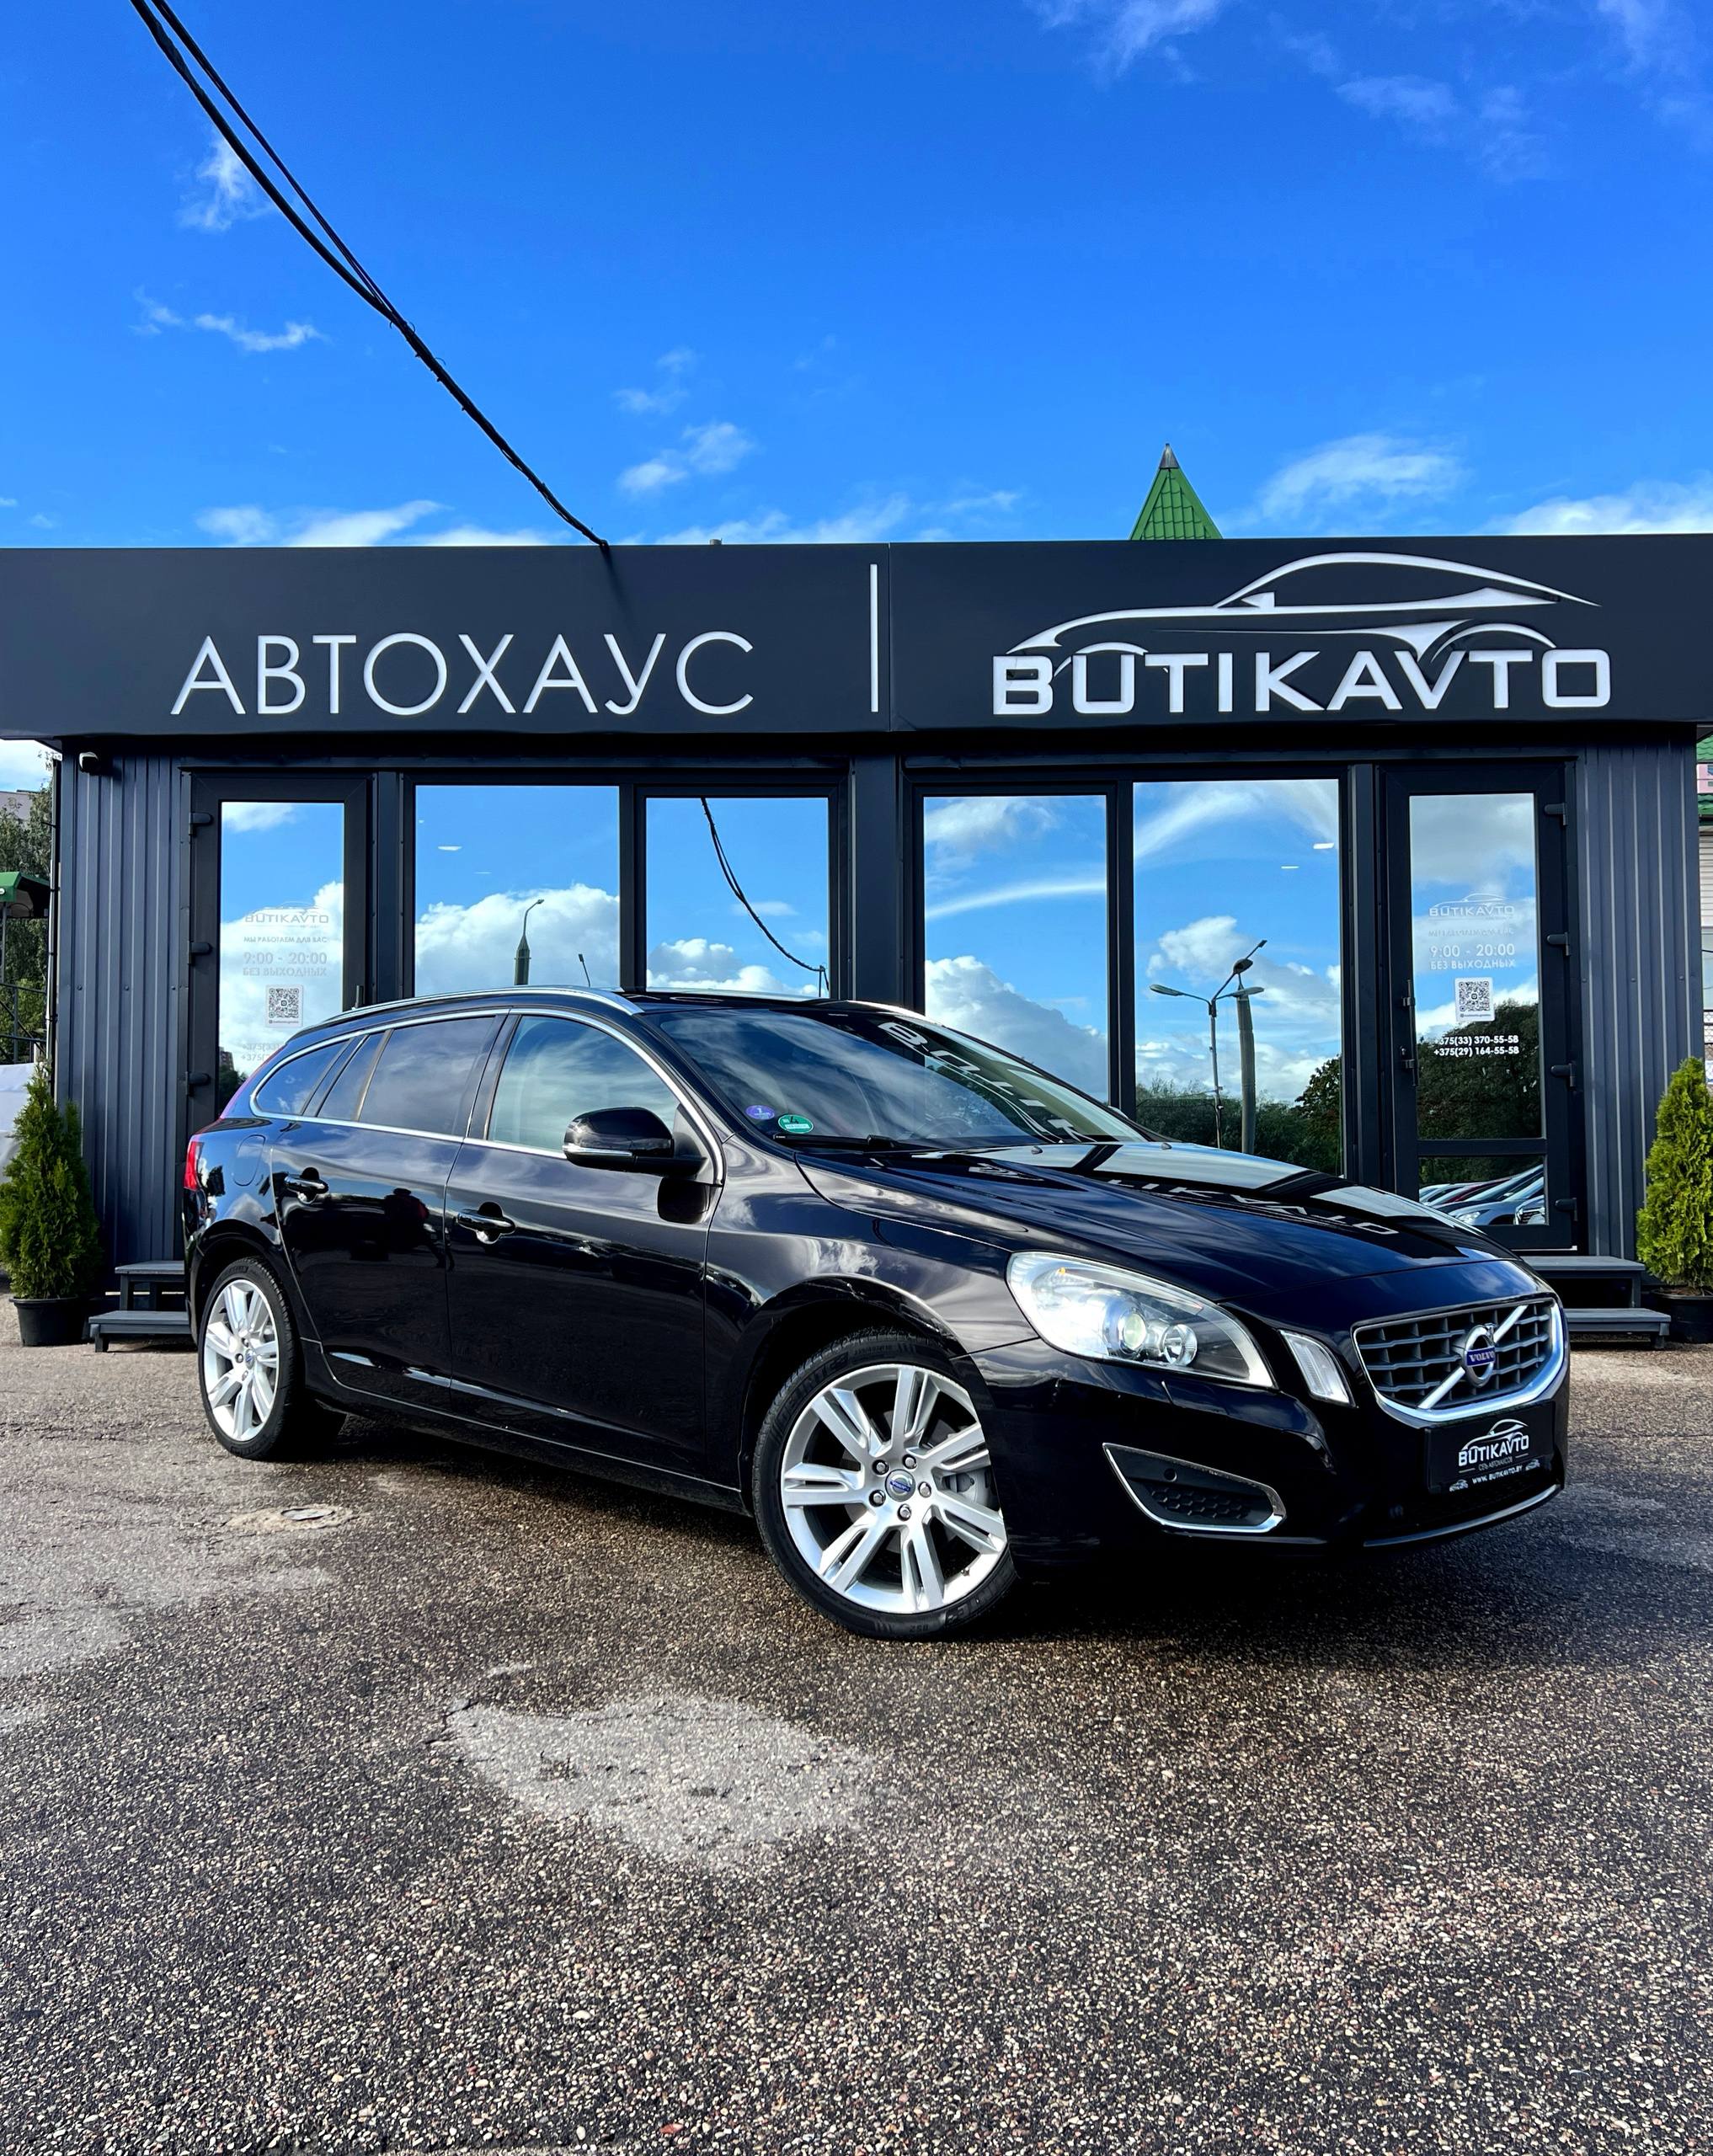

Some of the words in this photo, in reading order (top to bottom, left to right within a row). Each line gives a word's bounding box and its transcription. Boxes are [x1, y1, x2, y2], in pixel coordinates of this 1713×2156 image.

[170, 632, 755, 716] АВТОХАУС
[992, 648, 1611, 716] BUTIKAVTO
[1429, 905, 1515, 916] BUTIKAVTO
[245, 914, 329, 924] BUTIKAVTO
[1431, 945, 1460, 958] 9:00
[1476, 944, 1515, 957] 20:00
[243, 953, 274, 964] 9:00
[288, 953, 327, 964] 20:00
[1431, 961, 1449, 970] БЕЗ
[1451, 960, 1516, 969] ВЫХОДНЫХ
[243, 967, 260, 977] БЕЗ
[264, 967, 328, 977] ВЫХОДНЫХ
[1474, 1035, 1519, 1043] 370-55-58
[1433, 1047, 1473, 1057] +375(29)
[1476, 1046, 1519, 1055] 164-55-58
[1469, 1350, 1496, 1362] VOLVO
[1458, 1434, 1529, 1467] BUTIKAVTO
